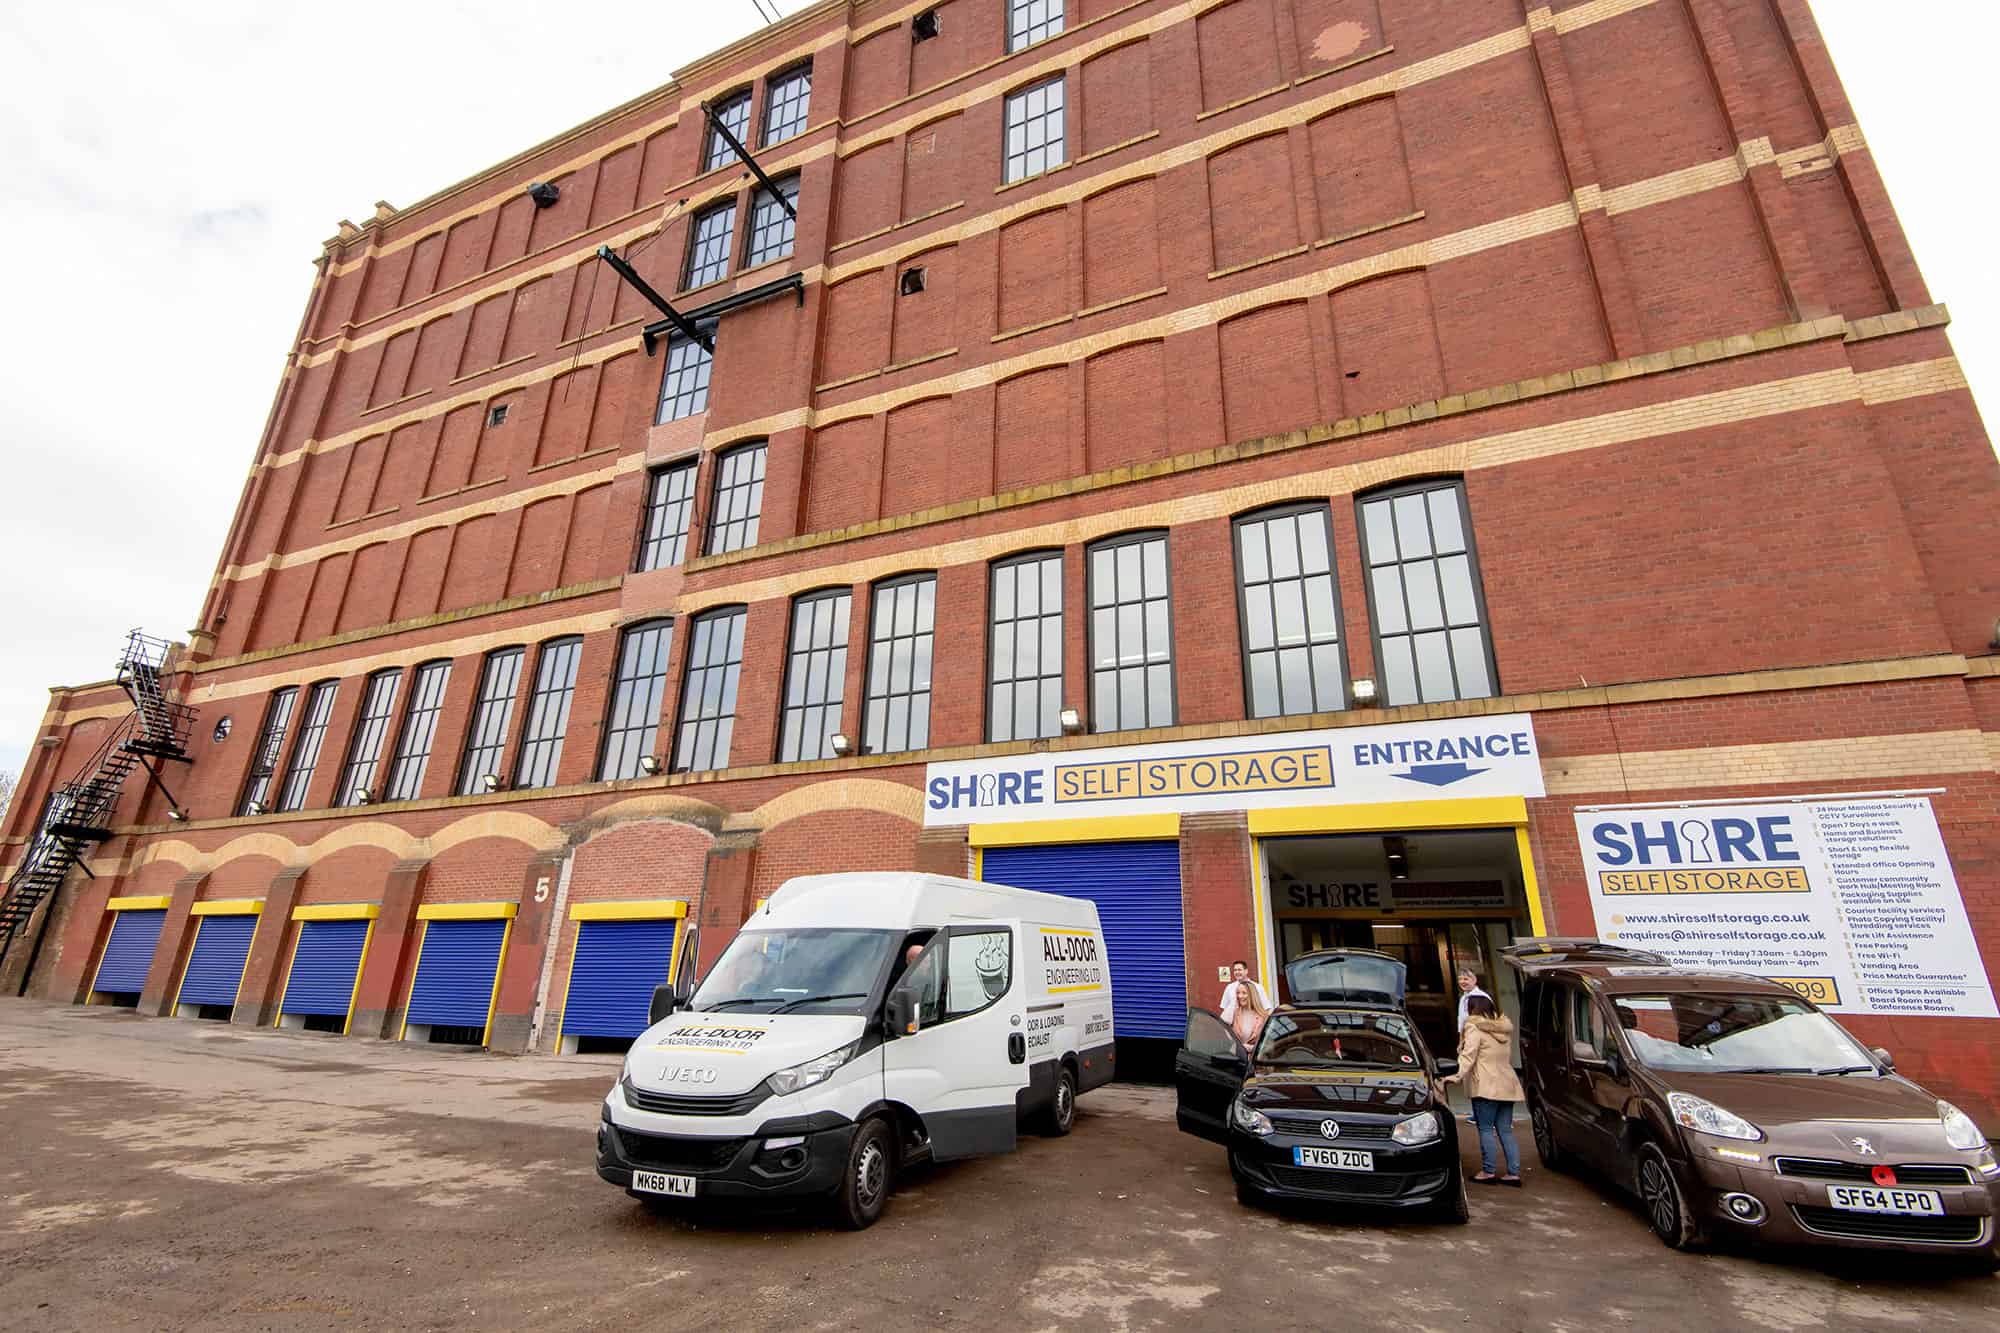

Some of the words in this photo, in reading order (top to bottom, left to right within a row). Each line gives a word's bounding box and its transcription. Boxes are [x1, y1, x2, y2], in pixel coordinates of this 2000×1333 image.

[1354, 733, 1531, 766] ENTRANCE
[928, 769, 1044, 810] SHIRE
[1063, 767, 1132, 796] SELF
[1149, 754, 1320, 791] STORAGE
[1883, 802, 1917, 810] Security
[1850, 821, 1870, 829] Days
[1593, 816, 1800, 865] SHIRE
[1898, 860, 1935, 868] Opening
[1607, 874, 1660, 893] SELF
[1674, 870, 1800, 892] STORAGE
[534, 877, 550, 902] 5
[1625, 913, 1811, 926] www.shireselfstorage.co.uk
[1619, 930, 1826, 942] enquires@shireselfstorage.co.uk
[1044, 936, 1098, 961] ALL-DOOR
[1875, 942, 1908, 950] Parking
[1721, 950, 1751, 958] Friday
[1728, 959, 1762, 967] Sunday
[1860, 962, 1897, 970] Vending
[1046, 968, 1090, 985] ENGINEERING
[1091, 968, 1101, 982] LTD
[1027, 1018, 1039, 1031] OOR
[669, 1028, 766, 1040] ALL-DOOR
[1028, 1033, 1050, 1048] ECIALIST
[658, 1038, 730, 1048] ENGINEERING
[731, 1041, 753, 1050] LTD
[658, 1066, 718, 1083] IVECO
[1303, 1149, 1339, 1165] FV60
[1343, 1151, 1370, 1167] ZDC
[637, 1173, 665, 1190] MK68
[668, 1177, 690, 1193] WLV
[1836, 1188, 1888, 1208] SF64
[1891, 1191, 1932, 1210] EPO
